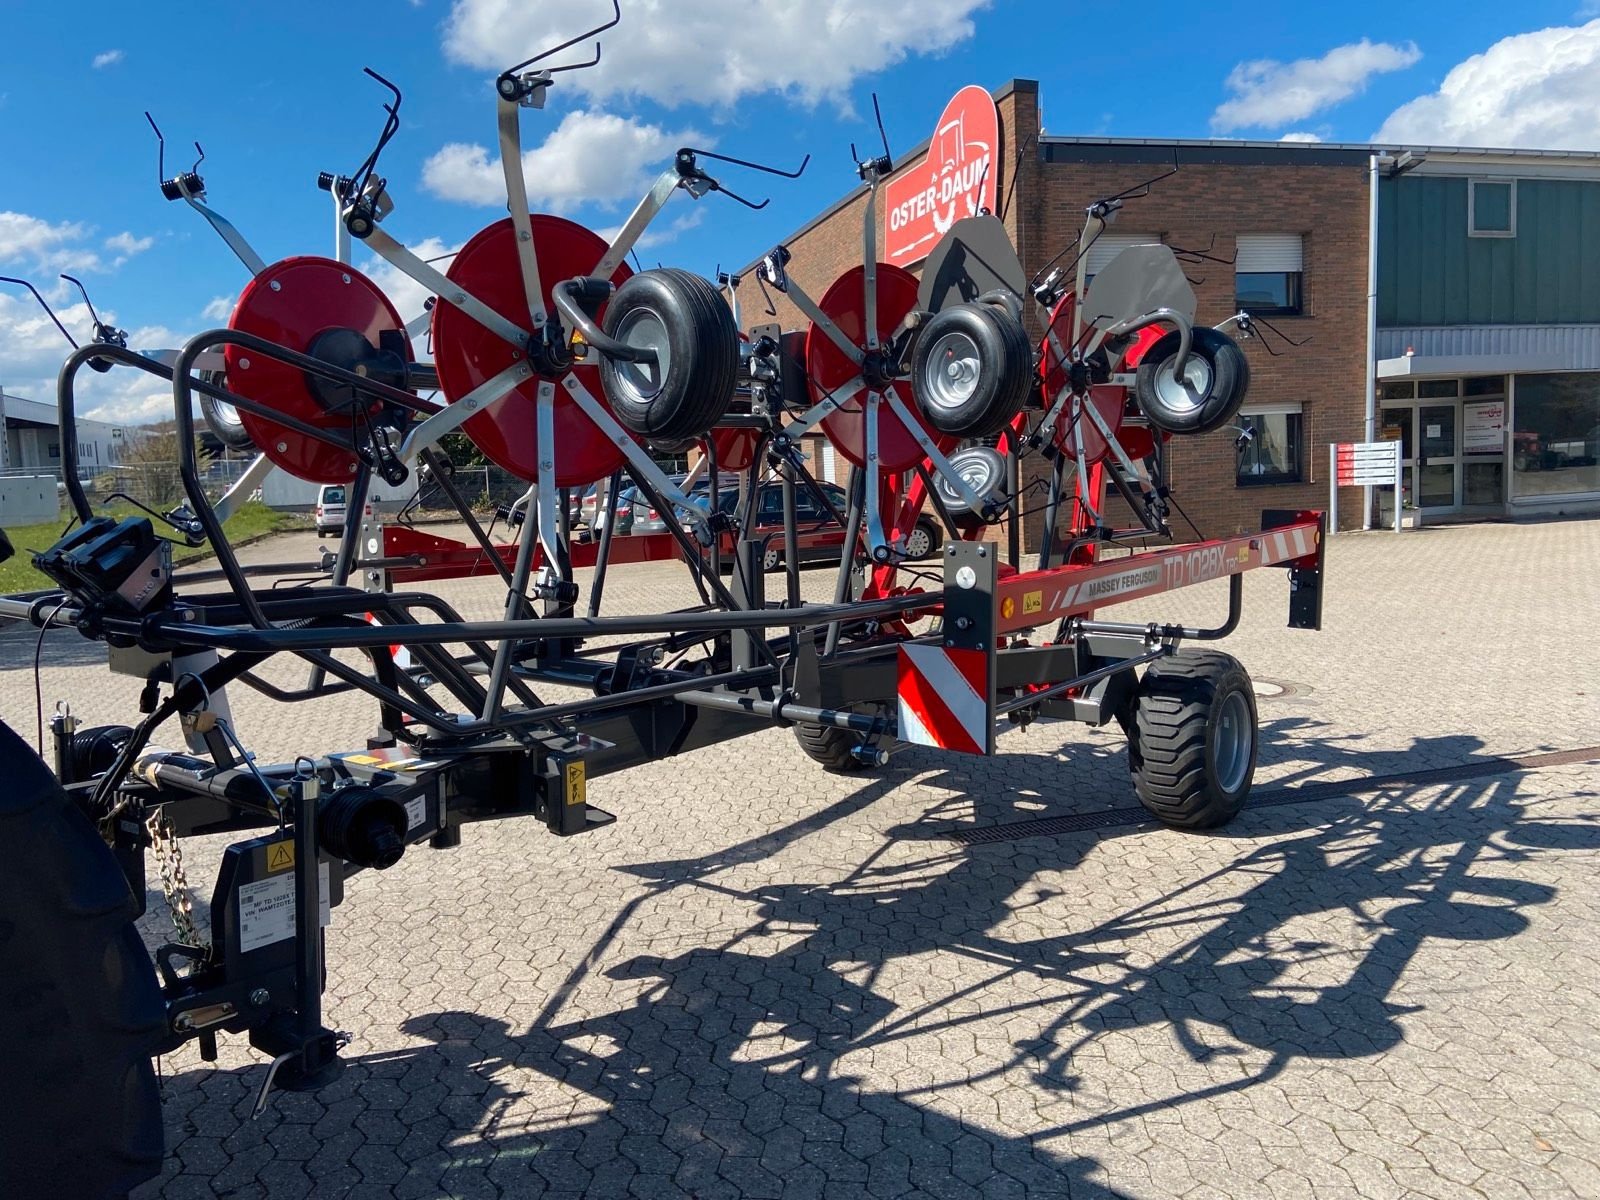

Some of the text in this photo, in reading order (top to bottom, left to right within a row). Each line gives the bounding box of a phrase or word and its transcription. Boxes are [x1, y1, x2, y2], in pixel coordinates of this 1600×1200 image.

[890, 153, 990, 232] OSTER-DAUM
[1089, 569, 1158, 597] MASSEY FERGUSON
[1164, 555, 1183, 590] TD
[1186, 546, 1227, 585] 1028X
